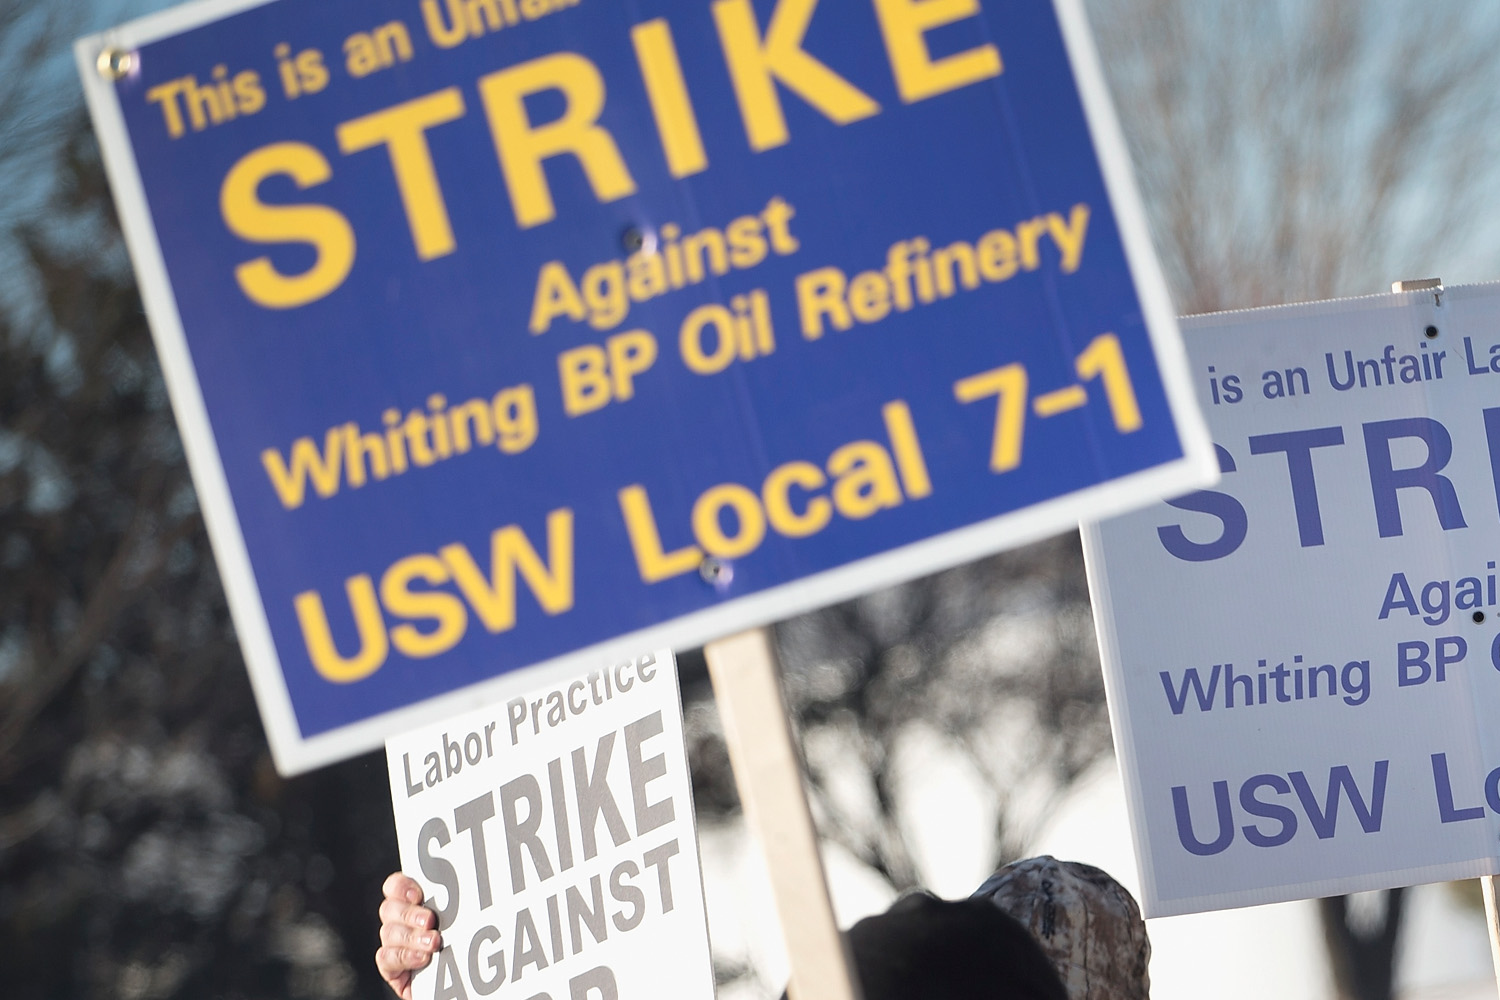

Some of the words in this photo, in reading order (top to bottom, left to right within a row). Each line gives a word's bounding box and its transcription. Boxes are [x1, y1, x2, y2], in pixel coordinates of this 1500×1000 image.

[147, 65, 266, 138] This
[273, 44, 329, 97] is
[345, 23, 413, 77] an
[220, 0, 1003, 309] STRIKE
[529, 196, 798, 335] Against
[262, 384, 538, 508] Whiting
[559, 328, 658, 416] BP
[680, 289, 775, 375] Oil
[796, 203, 1090, 339] Refinery
[1208, 366, 1243, 405] is
[1262, 367, 1309, 398] an
[1325, 343, 1447, 391] Unfair
[295, 508, 574, 682] USW
[619, 401, 931, 584] Local
[955, 334, 1144, 475] 7-1
[403, 721, 496, 797] Labor
[506, 652, 657, 746] Practice
[1159, 656, 1371, 715] Whiting
[1397, 636, 1467, 687] BP
[418, 710, 676, 930] STRIKE
[1171, 759, 1390, 856] USW
